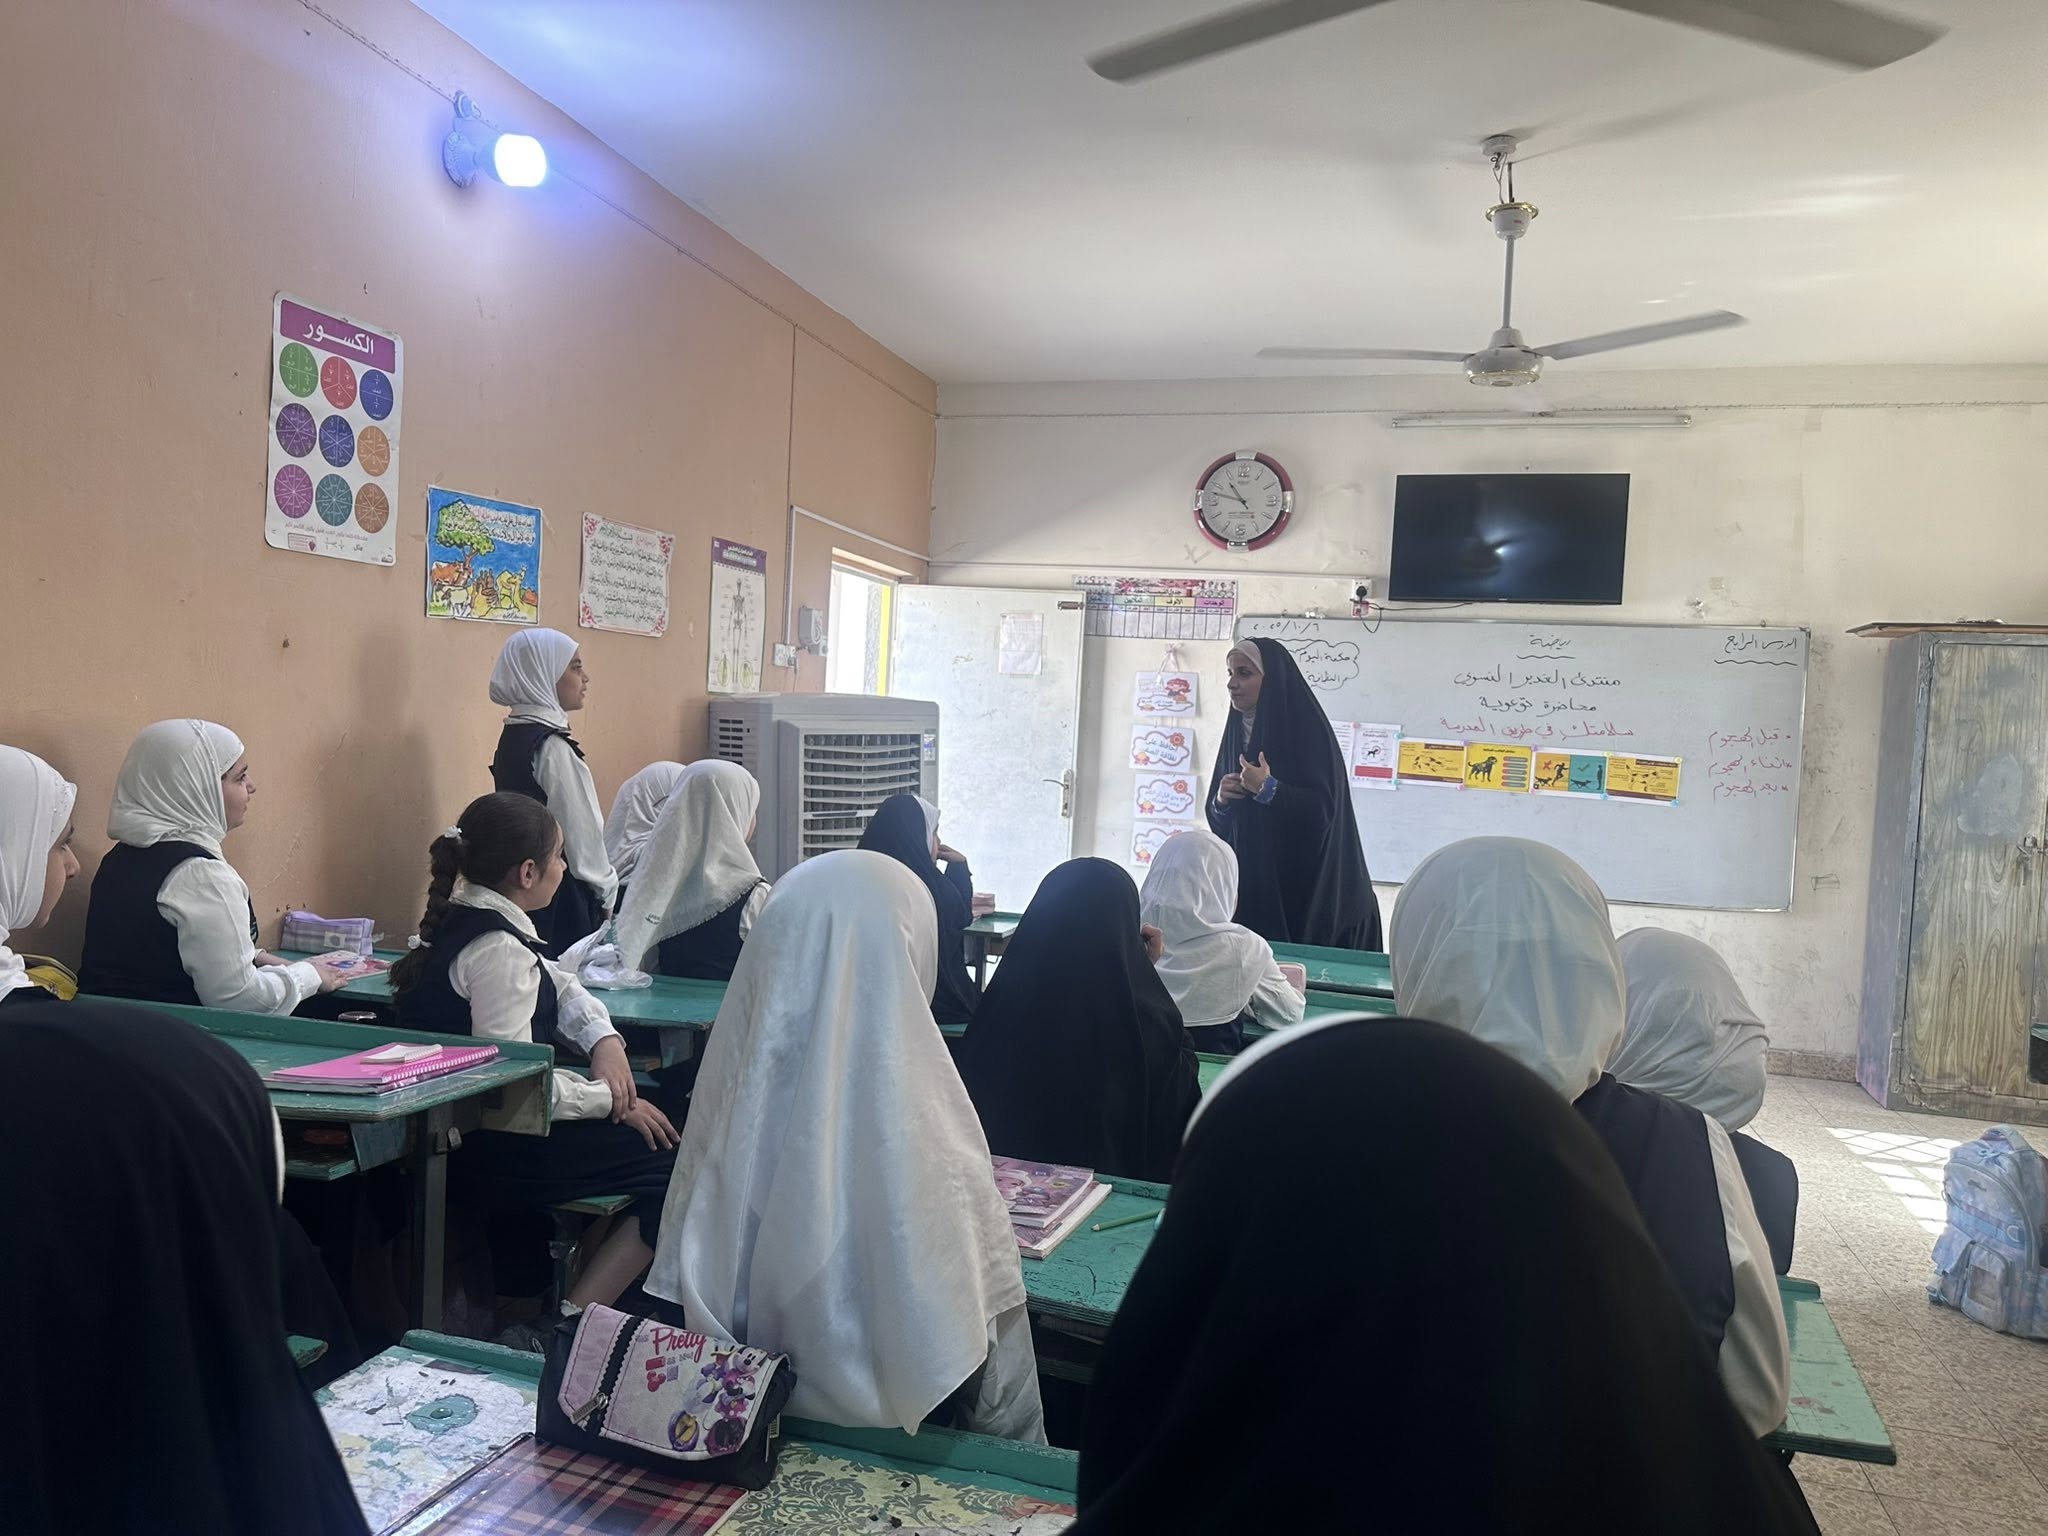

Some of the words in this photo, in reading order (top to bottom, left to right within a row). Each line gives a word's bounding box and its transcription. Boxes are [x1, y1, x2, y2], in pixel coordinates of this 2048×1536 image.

[302, 321, 374, 355] الكسور
[1536, 697, 1597, 718] محاضرة
[650, 1327, 707, 1363] Pretty
